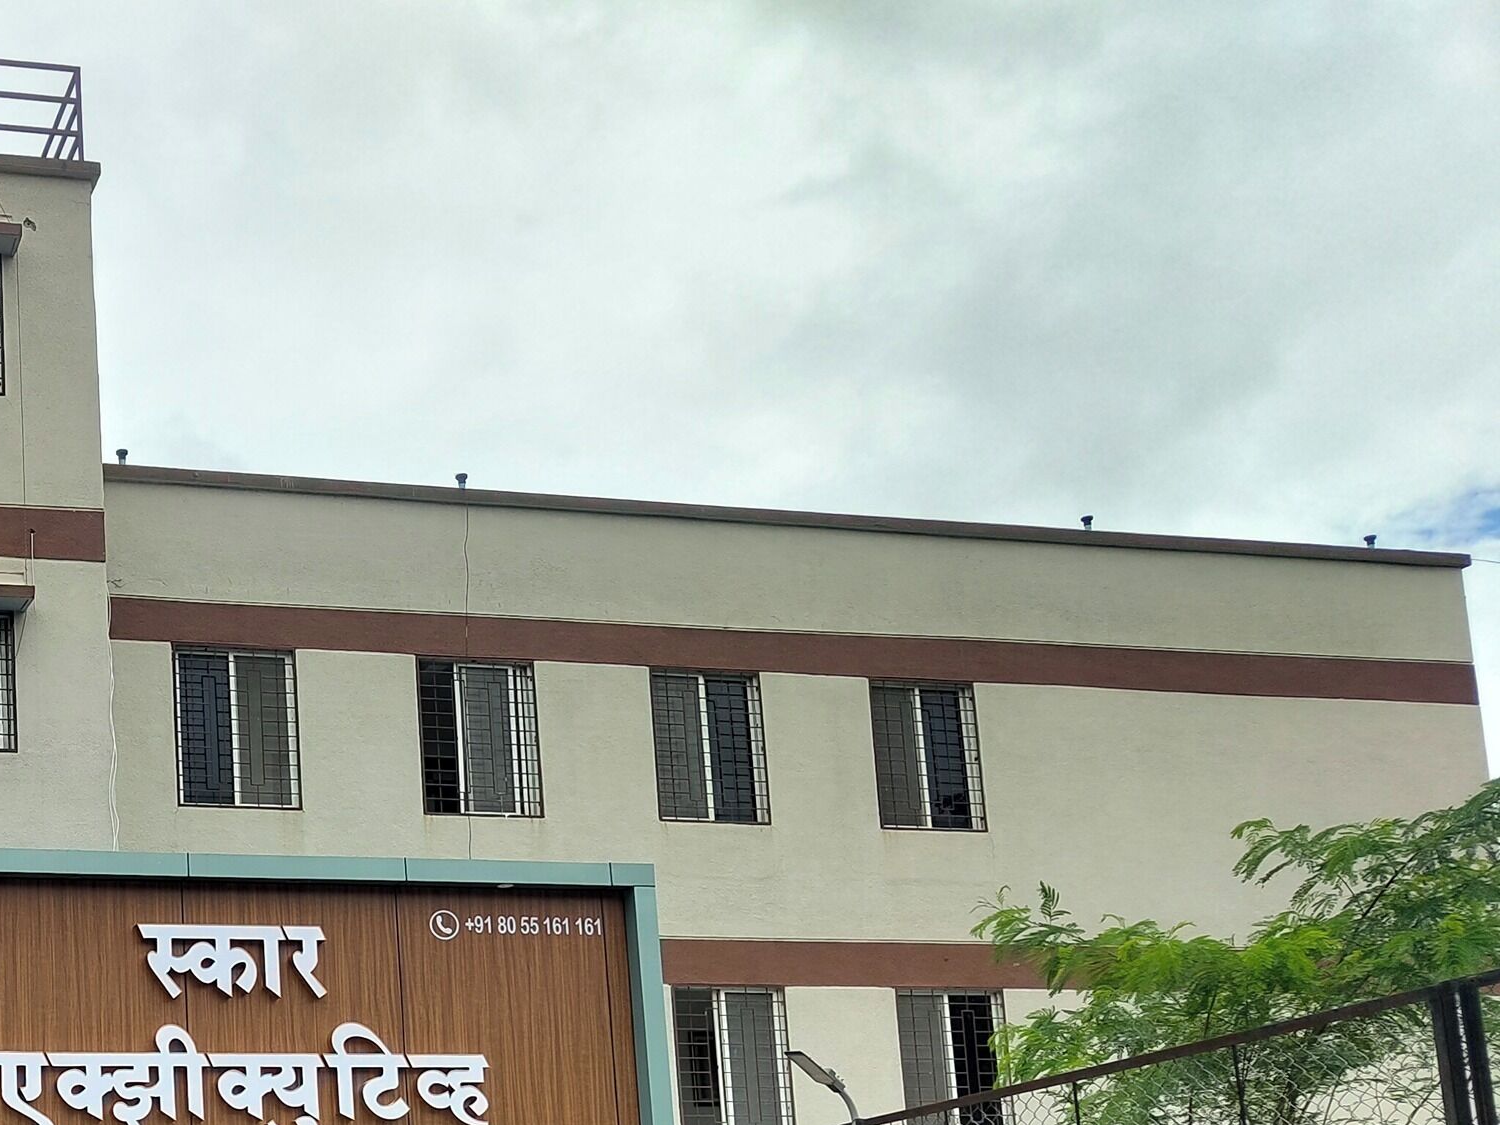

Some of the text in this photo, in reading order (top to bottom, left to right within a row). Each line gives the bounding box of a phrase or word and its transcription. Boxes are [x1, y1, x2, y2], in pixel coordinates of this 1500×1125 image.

[465, 915, 602, 936] +91 80 55 161 161
[135, 923, 328, 1000] स्कार
